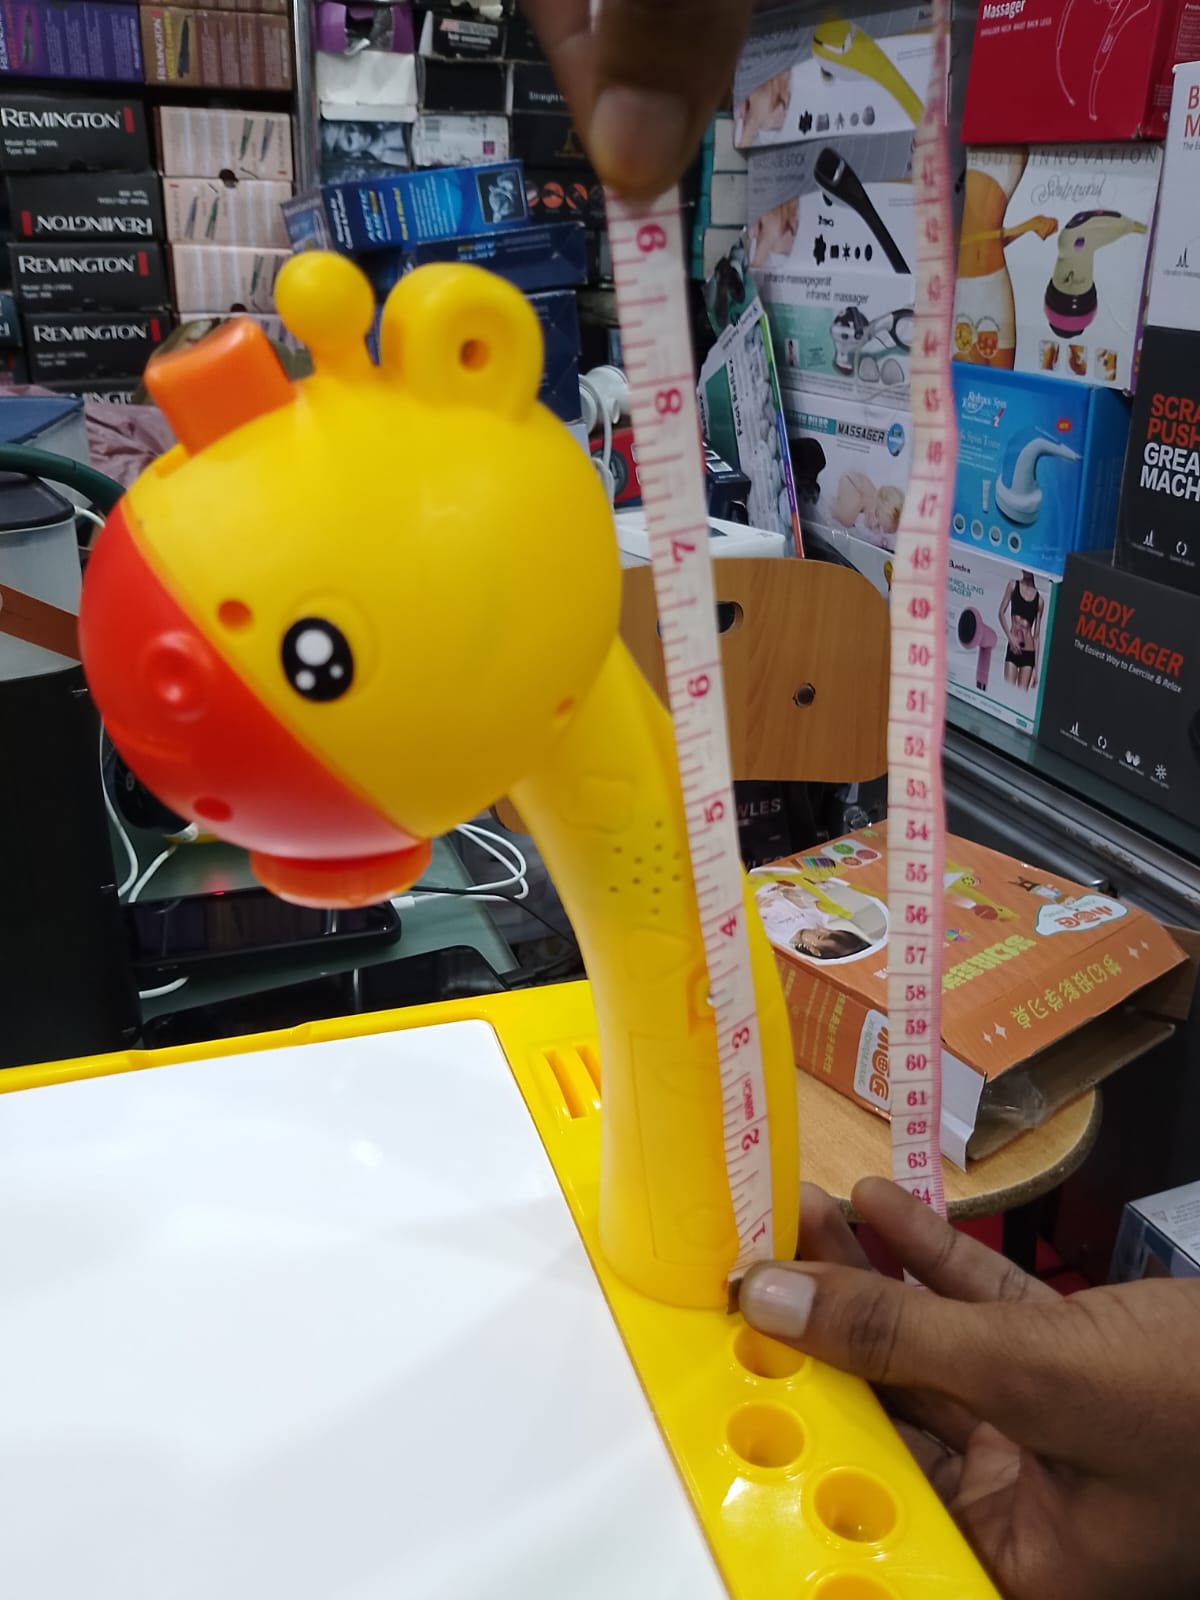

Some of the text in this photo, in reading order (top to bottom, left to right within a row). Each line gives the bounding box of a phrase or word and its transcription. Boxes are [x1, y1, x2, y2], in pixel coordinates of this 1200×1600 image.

[982, 0, 1026, 20] Massager
[0, 107, 121, 129] REMINGTON
[1031, 147, 1158, 166] INNOVATION
[37, 215, 153, 236] REMINGTON
[18, 256, 135, 273] REMINGTON
[33, 325, 147, 342] REMINGTON
[656, 388, 683, 414] 8
[838, 424, 885, 443] MASSAGER
[917, 495, 938, 517] 47
[671, 539, 696, 564] 7
[910, 545, 932, 569] 48
[908, 597, 931, 619] 49
[1079, 590, 1136, 628] BODY
[908, 644, 929, 666] 50
[1075, 614, 1184, 678] MASSAGER
[1074, 639, 1182, 694] The Easiest Way to Exercise & Relax
[688, 671, 711, 697] 6
[906, 690, 926, 712] 51
[904, 736, 926, 758] 52
[906, 779, 926, 800] 53
[703, 800, 725, 823] 5
[905, 820, 929, 841] 54
[905, 862, 929, 884] 55
[905, 905, 928, 924] 56
[719, 915, 737, 940] 4
[905, 946, 927, 964] 57
[905, 984, 928, 1001] 58
[1010, 953, 1122, 1029] 梦幻投影学习桌
[732, 1026, 750, 1049] 3
[905, 1018, 928, 1036] 59
[905, 1054, 928, 1072] 60
[906, 1090, 928, 1106] 61
[906, 1119, 928, 1135] 62
[742, 1127, 760, 1151] 2
[907, 1150, 929, 1168] 63
[751, 1222, 767, 1244] 1
